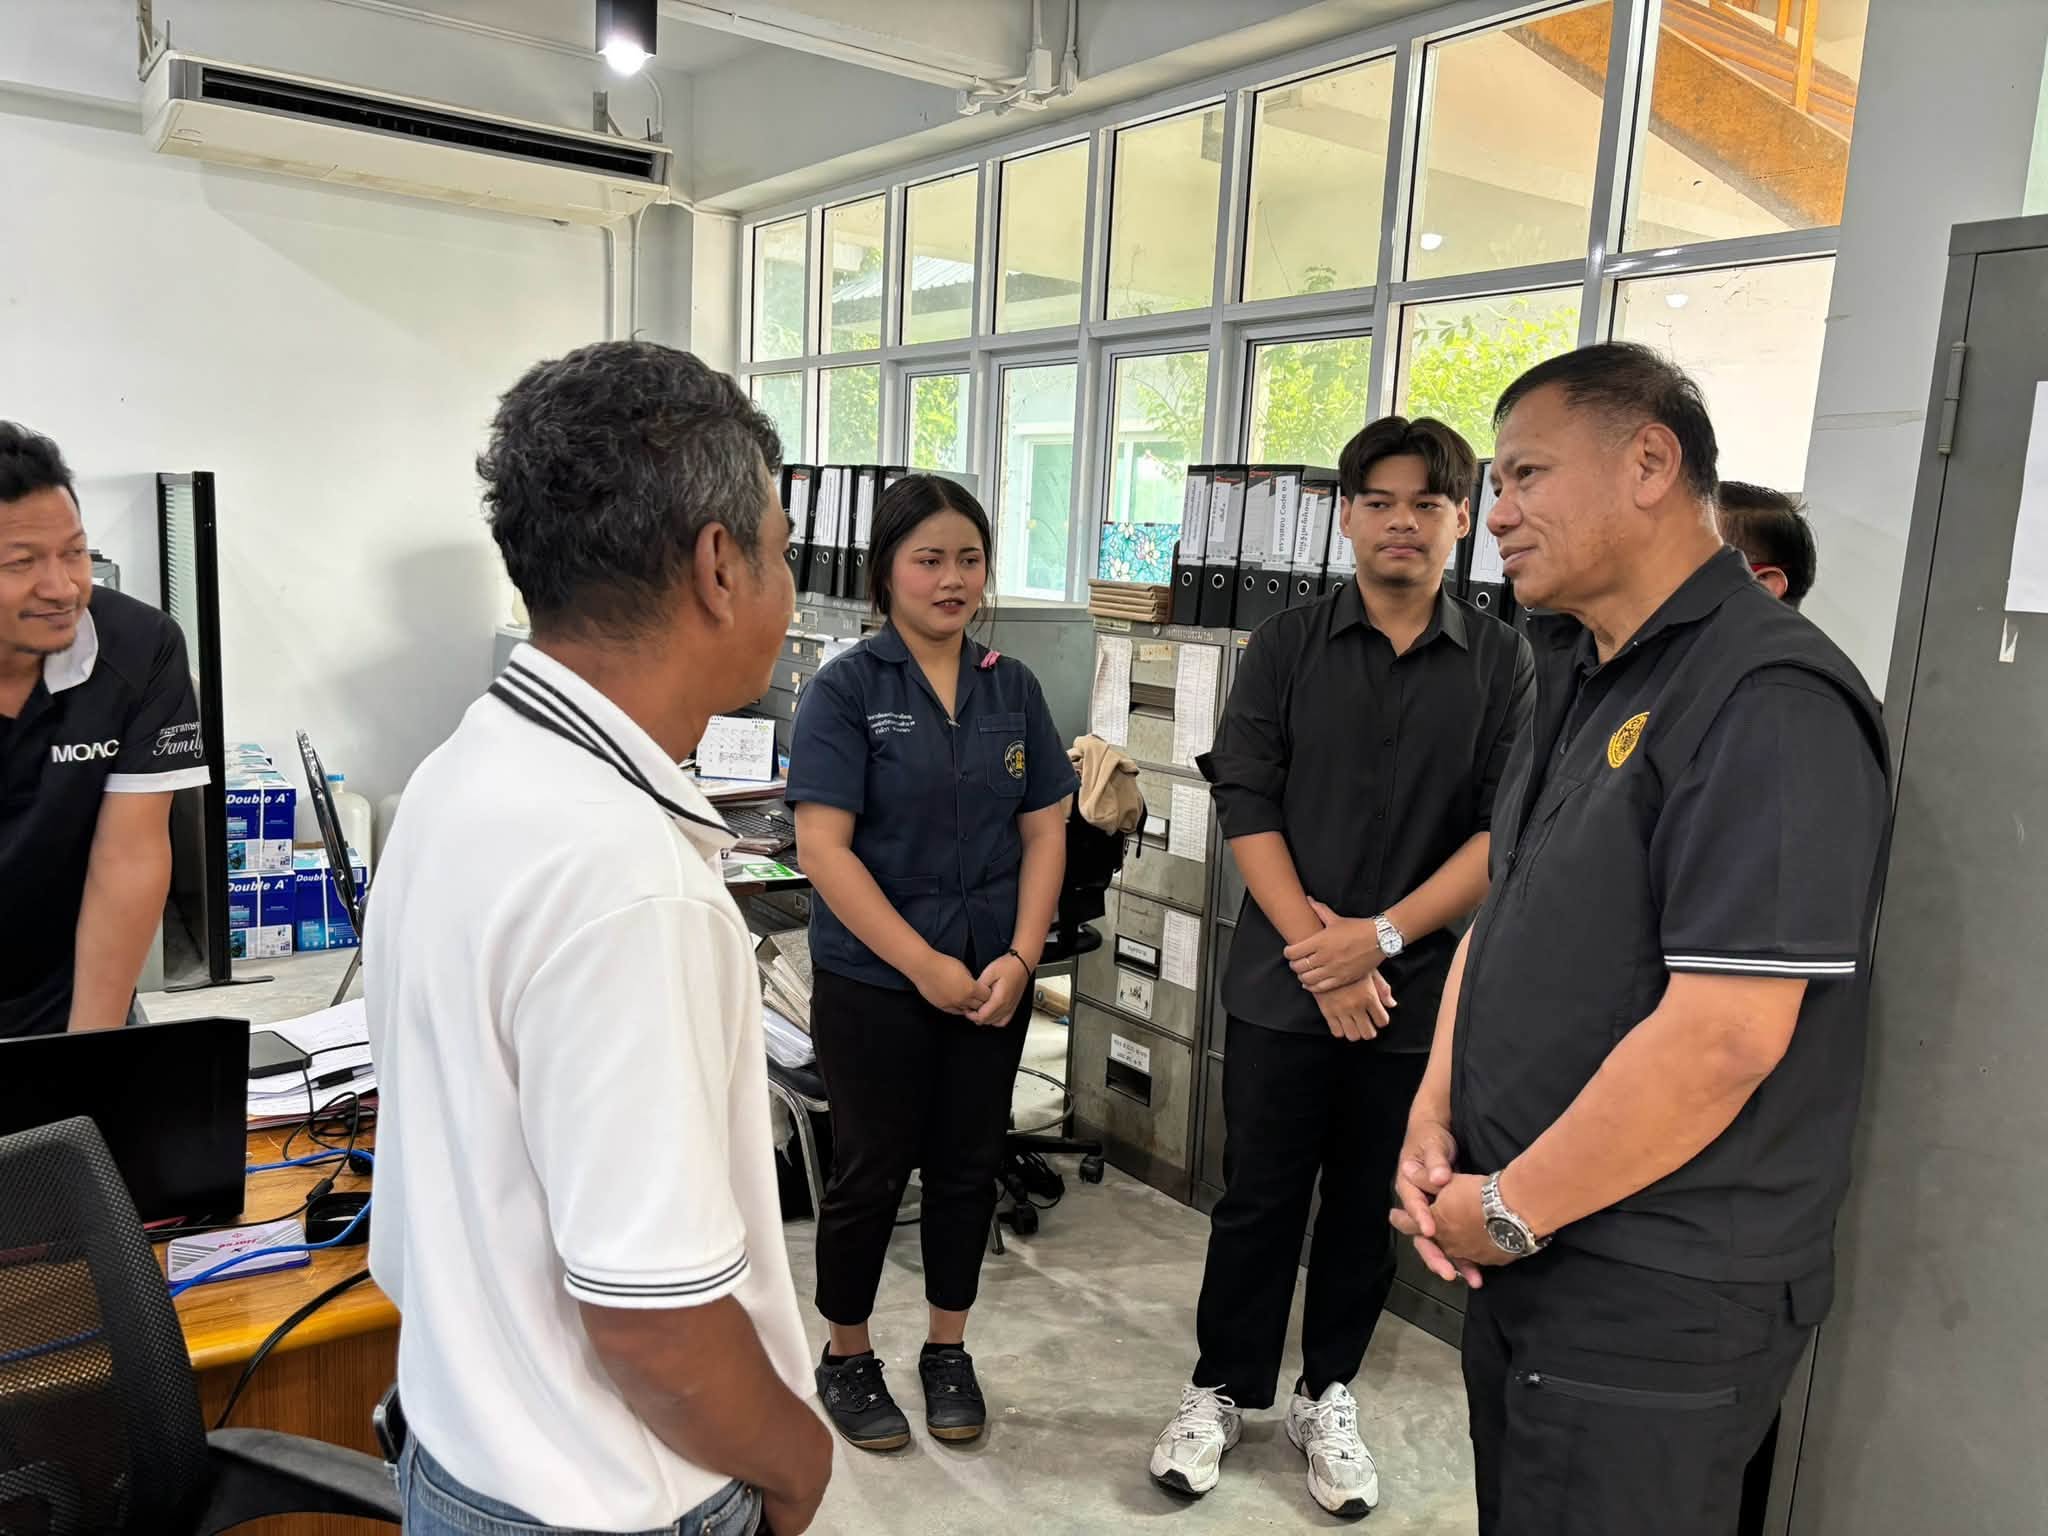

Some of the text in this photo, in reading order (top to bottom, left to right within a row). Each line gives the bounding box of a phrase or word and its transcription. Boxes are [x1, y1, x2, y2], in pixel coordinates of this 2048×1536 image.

[1280, 493, 1288, 516] Code
[51, 738, 121, 763] MOAC
[152, 727, 204, 760] Family
[226, 792, 287, 805] Doube A
[274, 879, 285, 890] A
